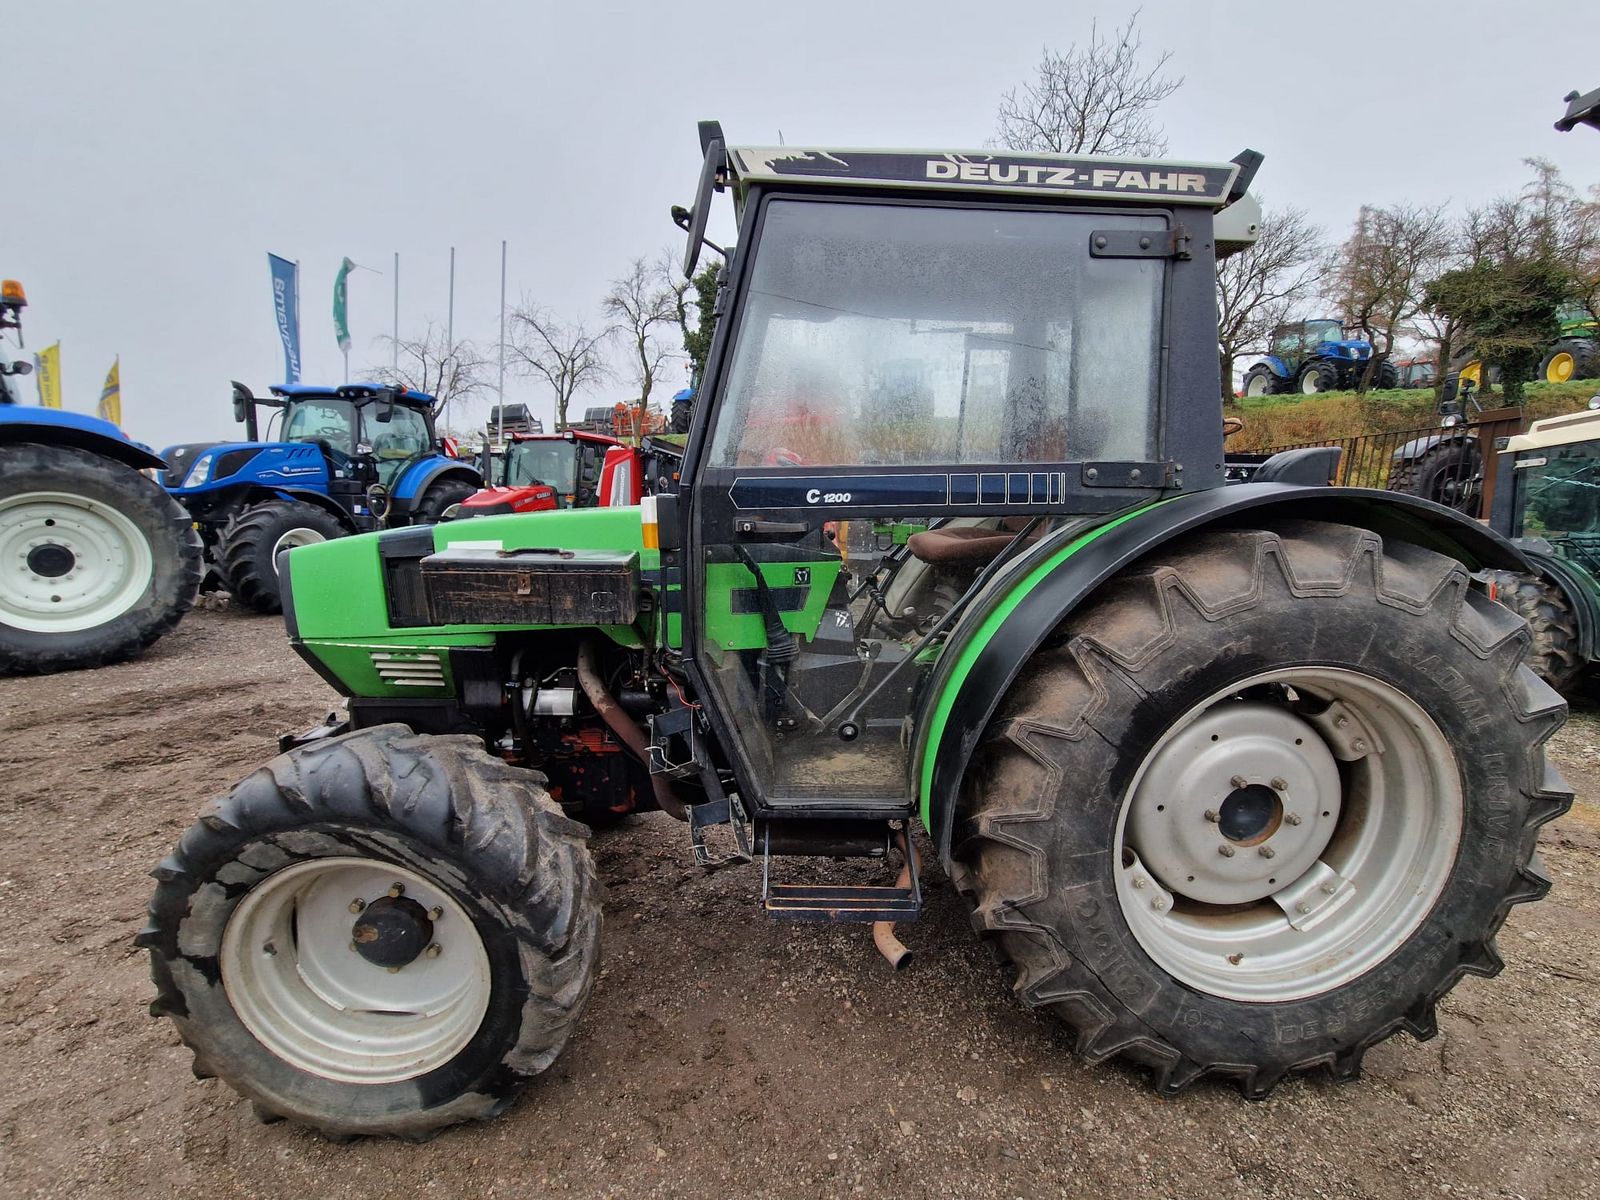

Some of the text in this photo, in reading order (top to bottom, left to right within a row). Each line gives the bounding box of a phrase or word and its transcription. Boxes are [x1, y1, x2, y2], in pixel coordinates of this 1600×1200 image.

[926, 159, 1206, 193] DEUTZ-FAHR
[806, 489, 852, 504] C 1200
